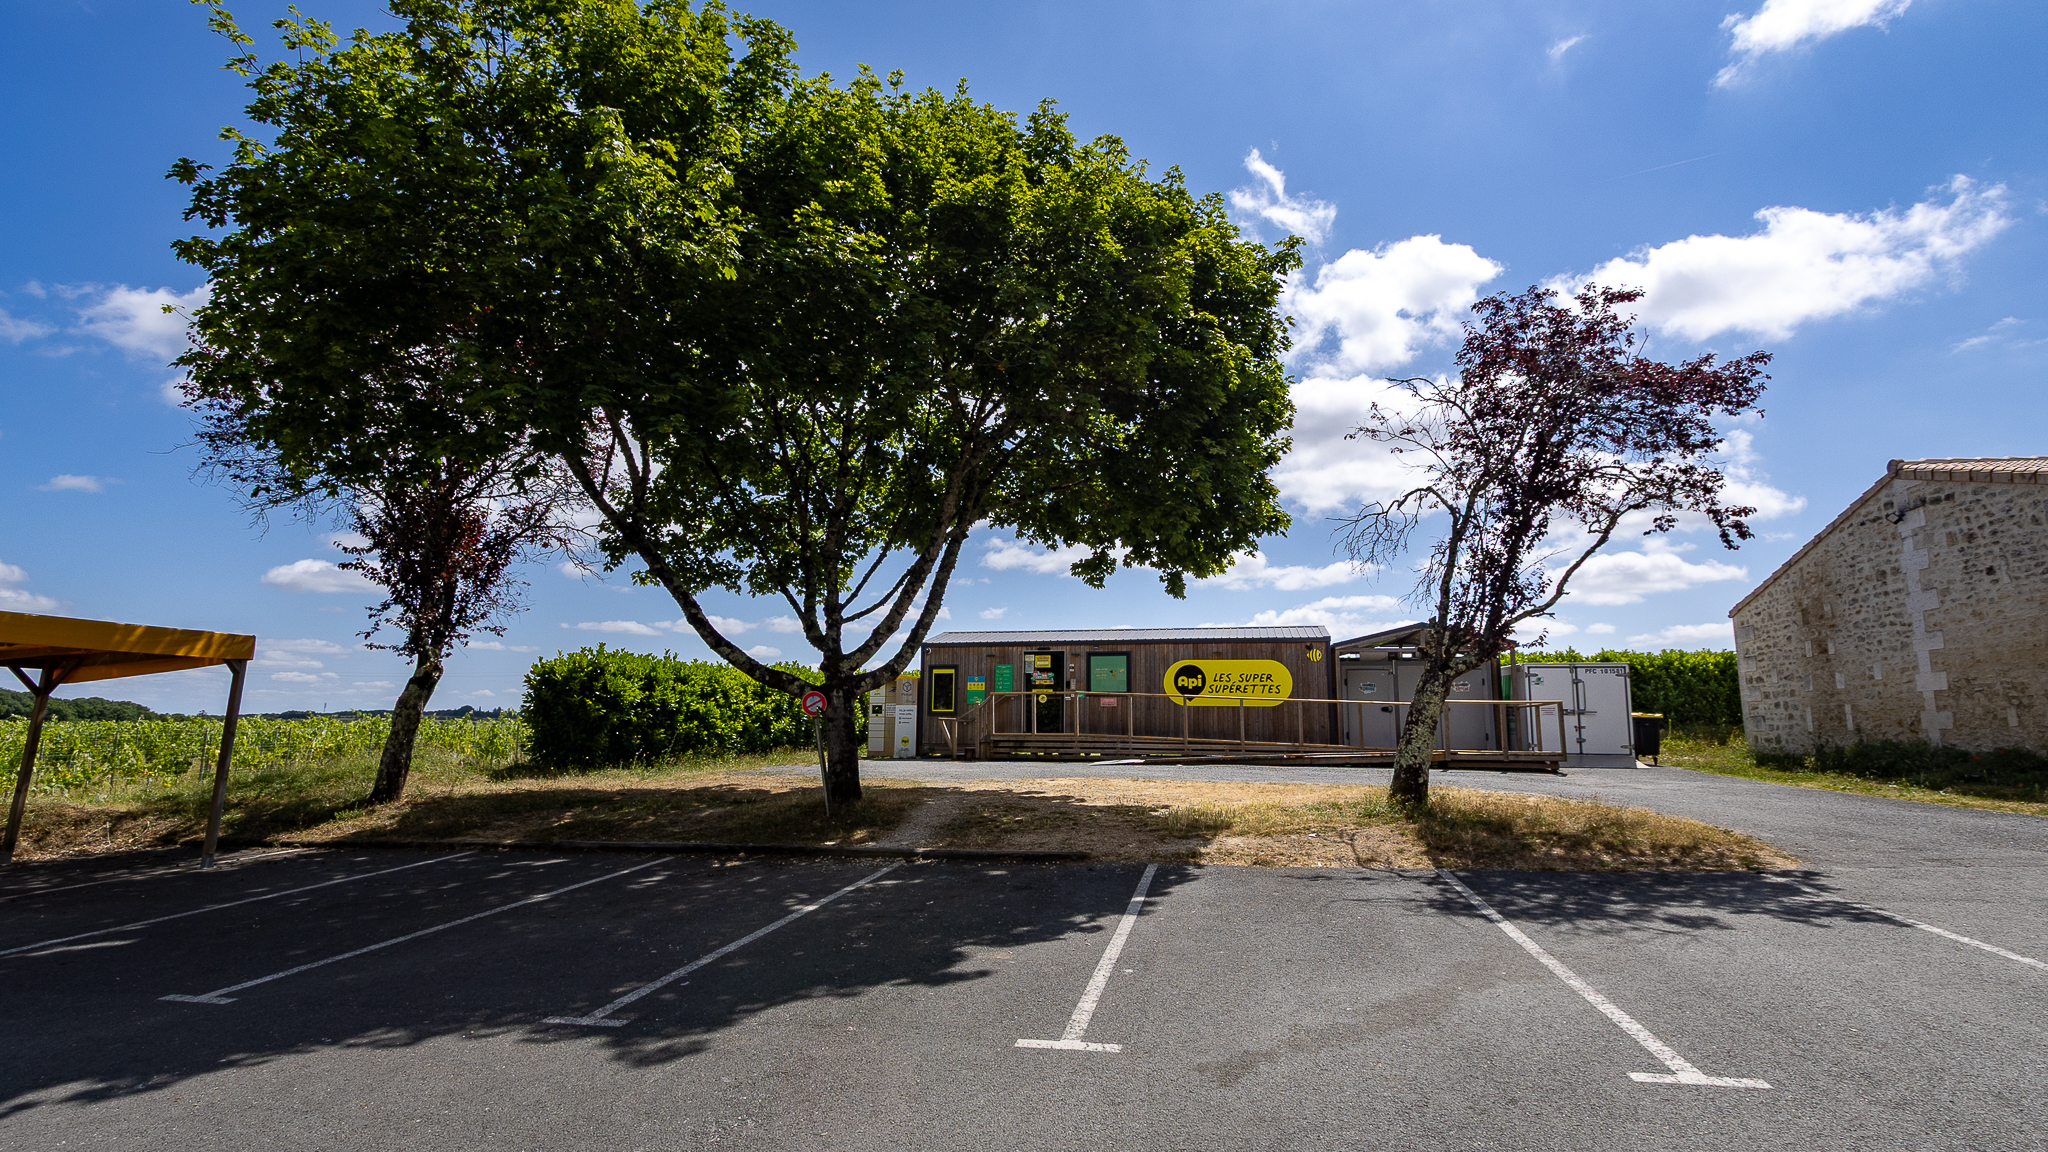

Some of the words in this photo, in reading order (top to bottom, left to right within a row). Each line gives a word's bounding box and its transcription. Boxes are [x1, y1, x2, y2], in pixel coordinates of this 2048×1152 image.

[1177, 674, 1202, 689] Api
[1213, 673, 1232, 682] LES
[1238, 673, 1274, 682] SUPER
[1208, 681, 1281, 694] SUPÉRETTES
